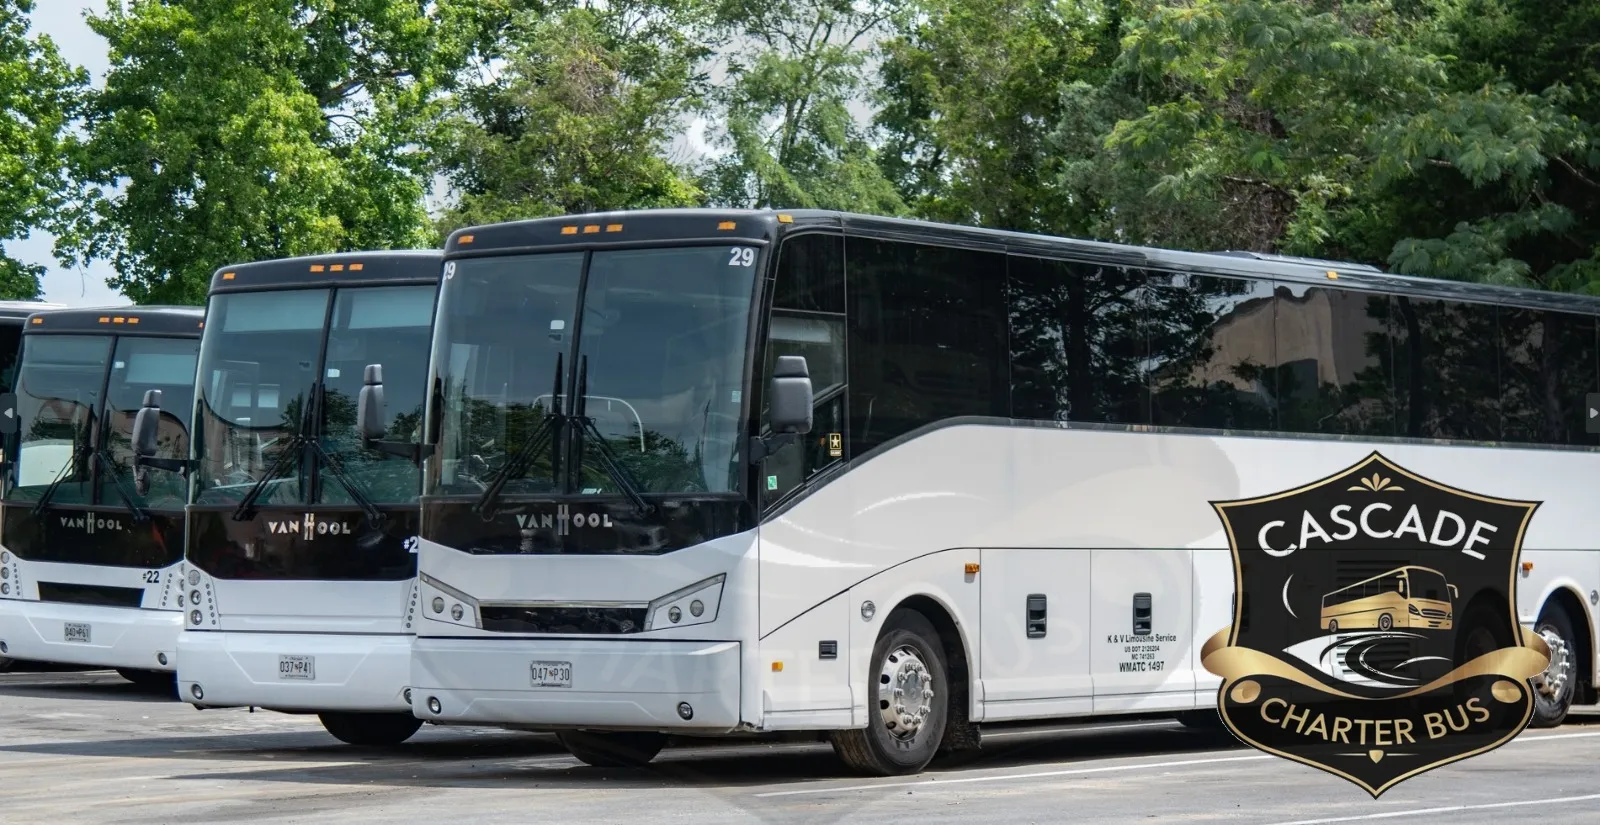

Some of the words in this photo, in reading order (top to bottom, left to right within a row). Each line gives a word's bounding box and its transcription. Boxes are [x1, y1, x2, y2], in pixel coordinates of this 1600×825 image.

[728, 246, 755, 267] 29
[1107, 635, 1112, 643] K
[1114, 635, 1118, 643] &
[1119, 634, 1125, 643] V
[1125, 634, 1154, 643] Limousine
[1155, 633, 1177, 642] Service
[1119, 661, 1146, 673] WMATC
[1148, 661, 1164, 671] 1497
